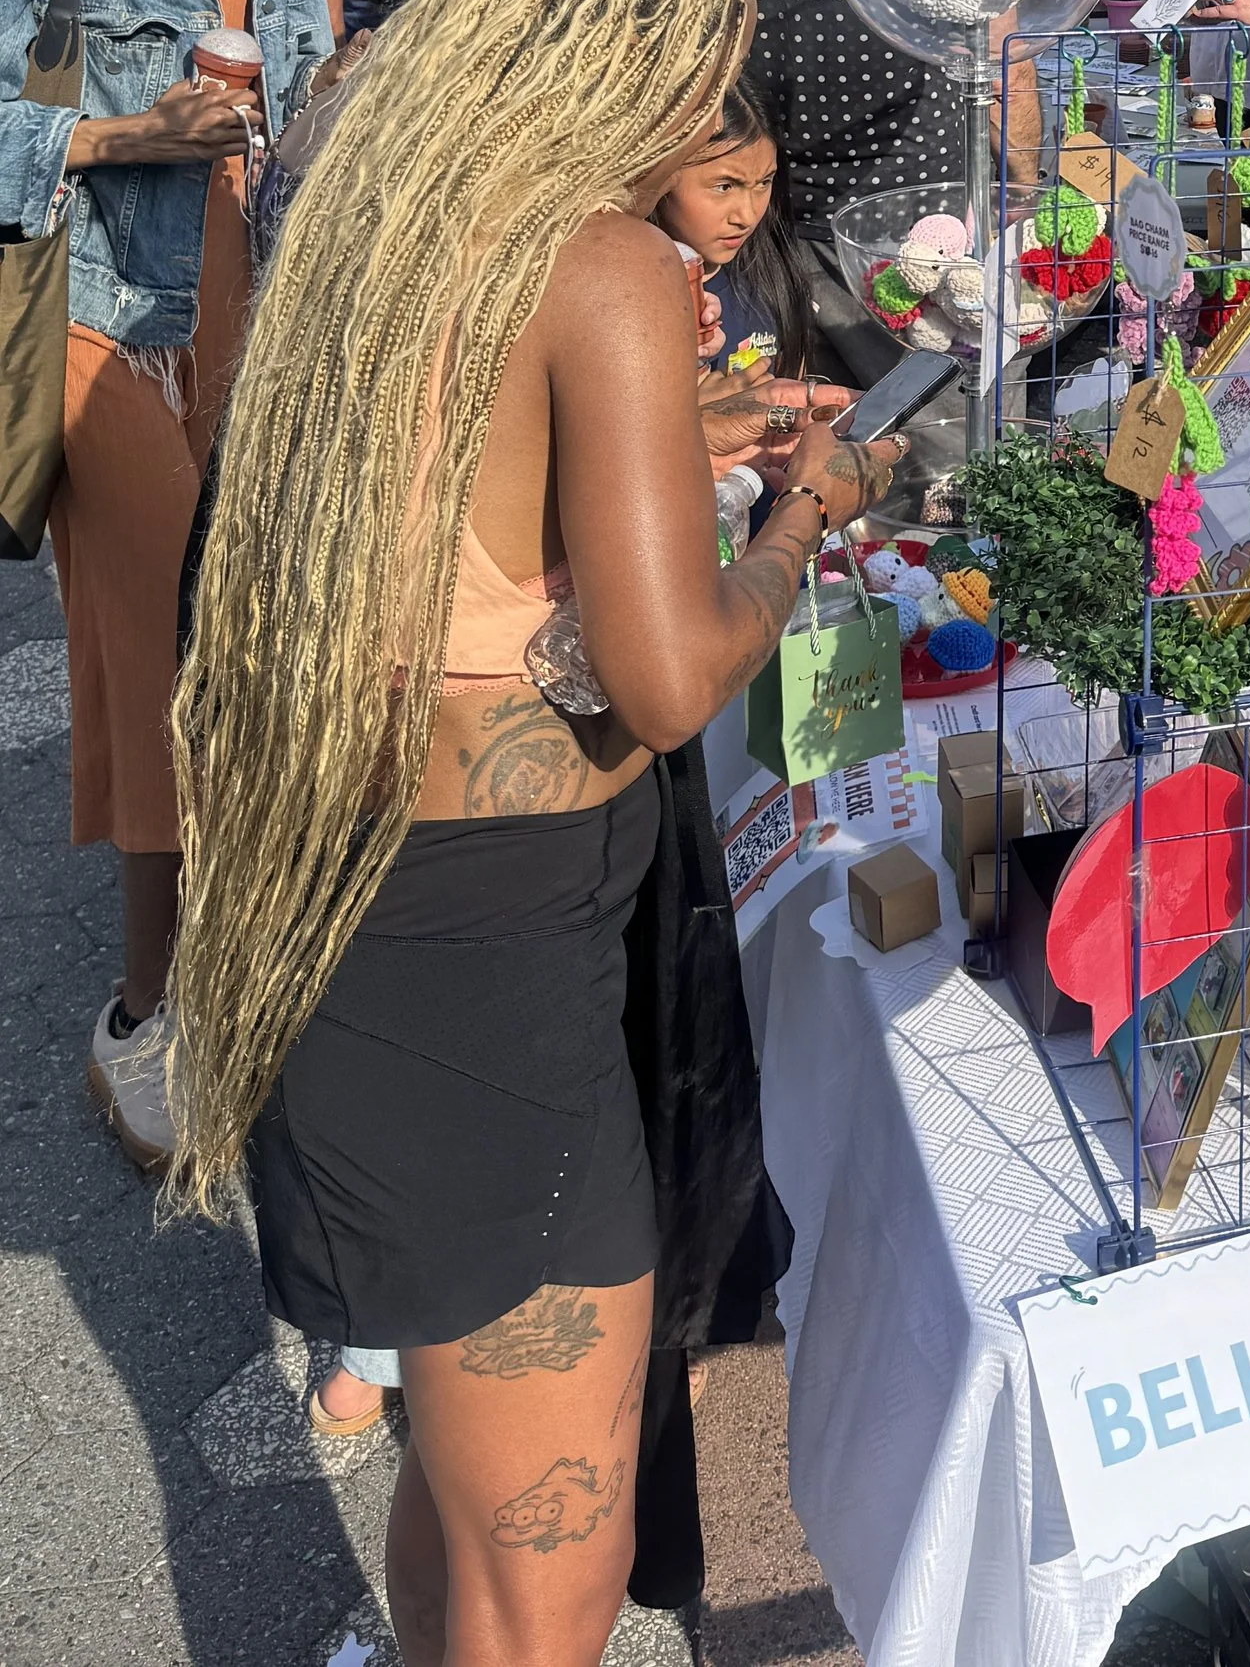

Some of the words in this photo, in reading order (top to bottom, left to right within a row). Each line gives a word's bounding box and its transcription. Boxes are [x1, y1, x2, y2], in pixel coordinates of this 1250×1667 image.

[1129, 216, 1144, 230] BAG
[1144, 222, 1170, 239] CHARM
[1129, 228, 1147, 243] PRICE
[1147, 236, 1170, 251] RANGE
[843, 761, 870, 783] AN
[844, 780, 875, 821] HERE
